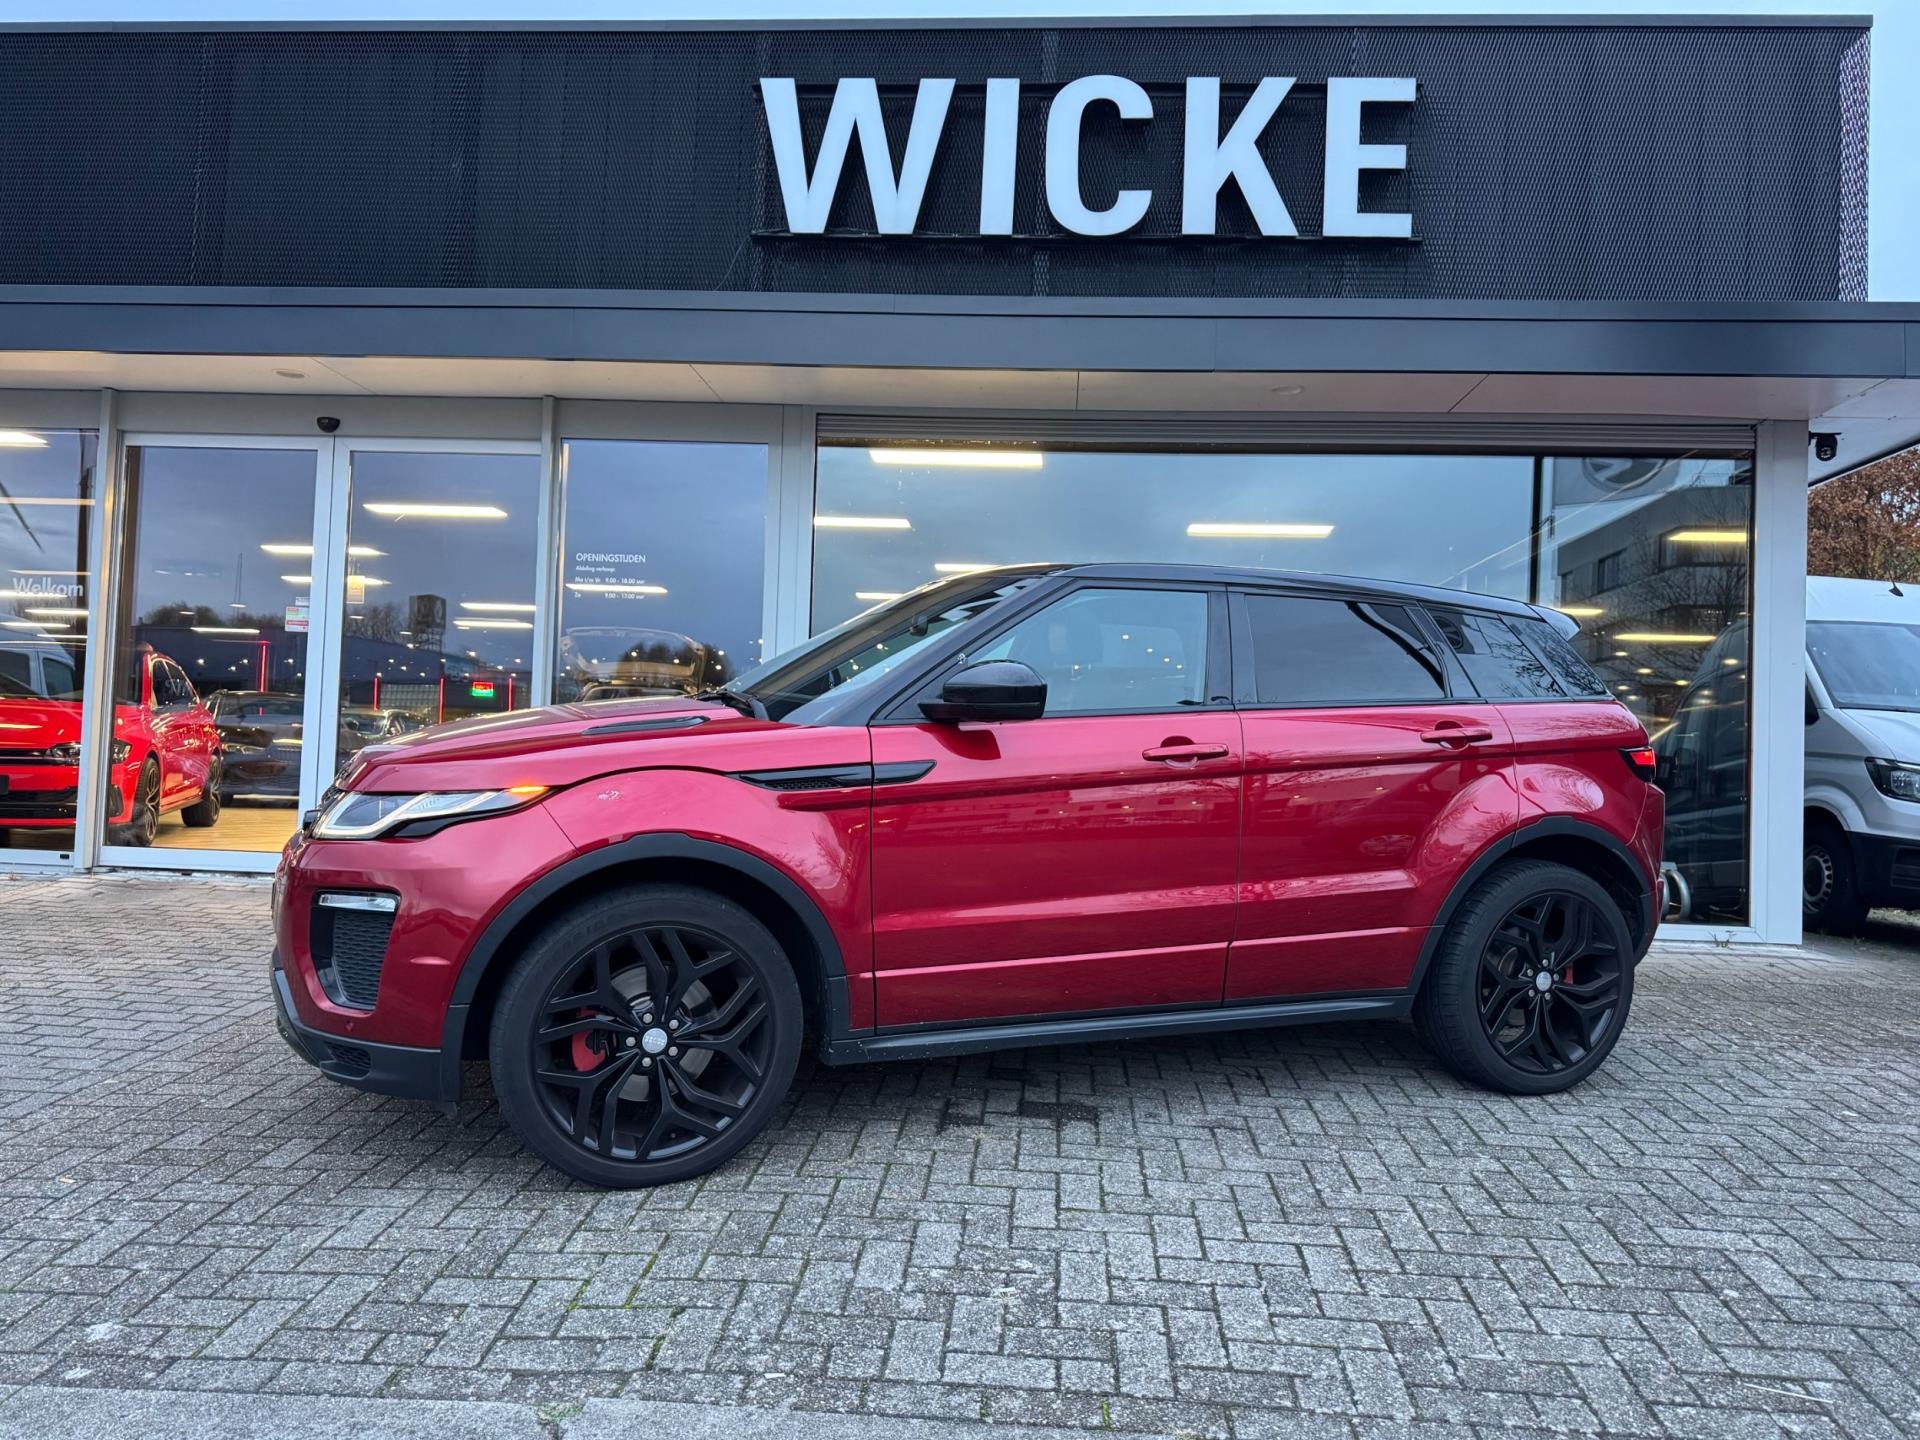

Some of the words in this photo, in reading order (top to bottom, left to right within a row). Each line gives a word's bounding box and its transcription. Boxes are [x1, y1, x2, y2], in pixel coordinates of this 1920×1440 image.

[760, 75, 1416, 237] WICKE
[575, 552, 646, 563] OPENINGSTIJDEN
[12, 576, 84, 597] Welkom
